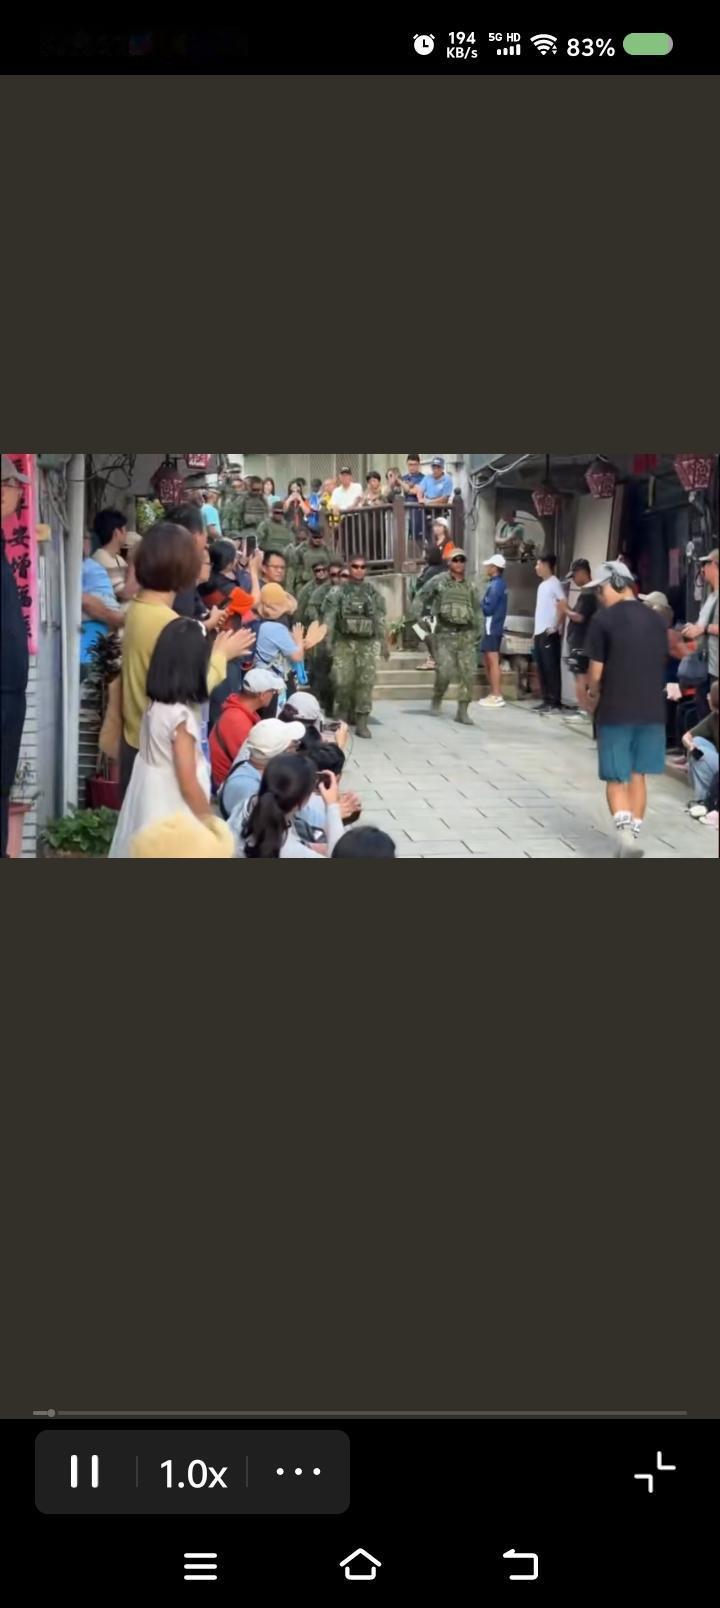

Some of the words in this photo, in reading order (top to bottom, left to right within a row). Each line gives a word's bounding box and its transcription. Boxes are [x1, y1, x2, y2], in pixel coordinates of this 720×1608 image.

[448, 31, 476, 45] 194
[488, 32, 503, 43] 5G
[506, 32, 521, 43] HD
[446, 46, 479, 60] KB/s
[566, 37, 617, 58] 83%
[160, 1459, 228, 1489] 1.0x
